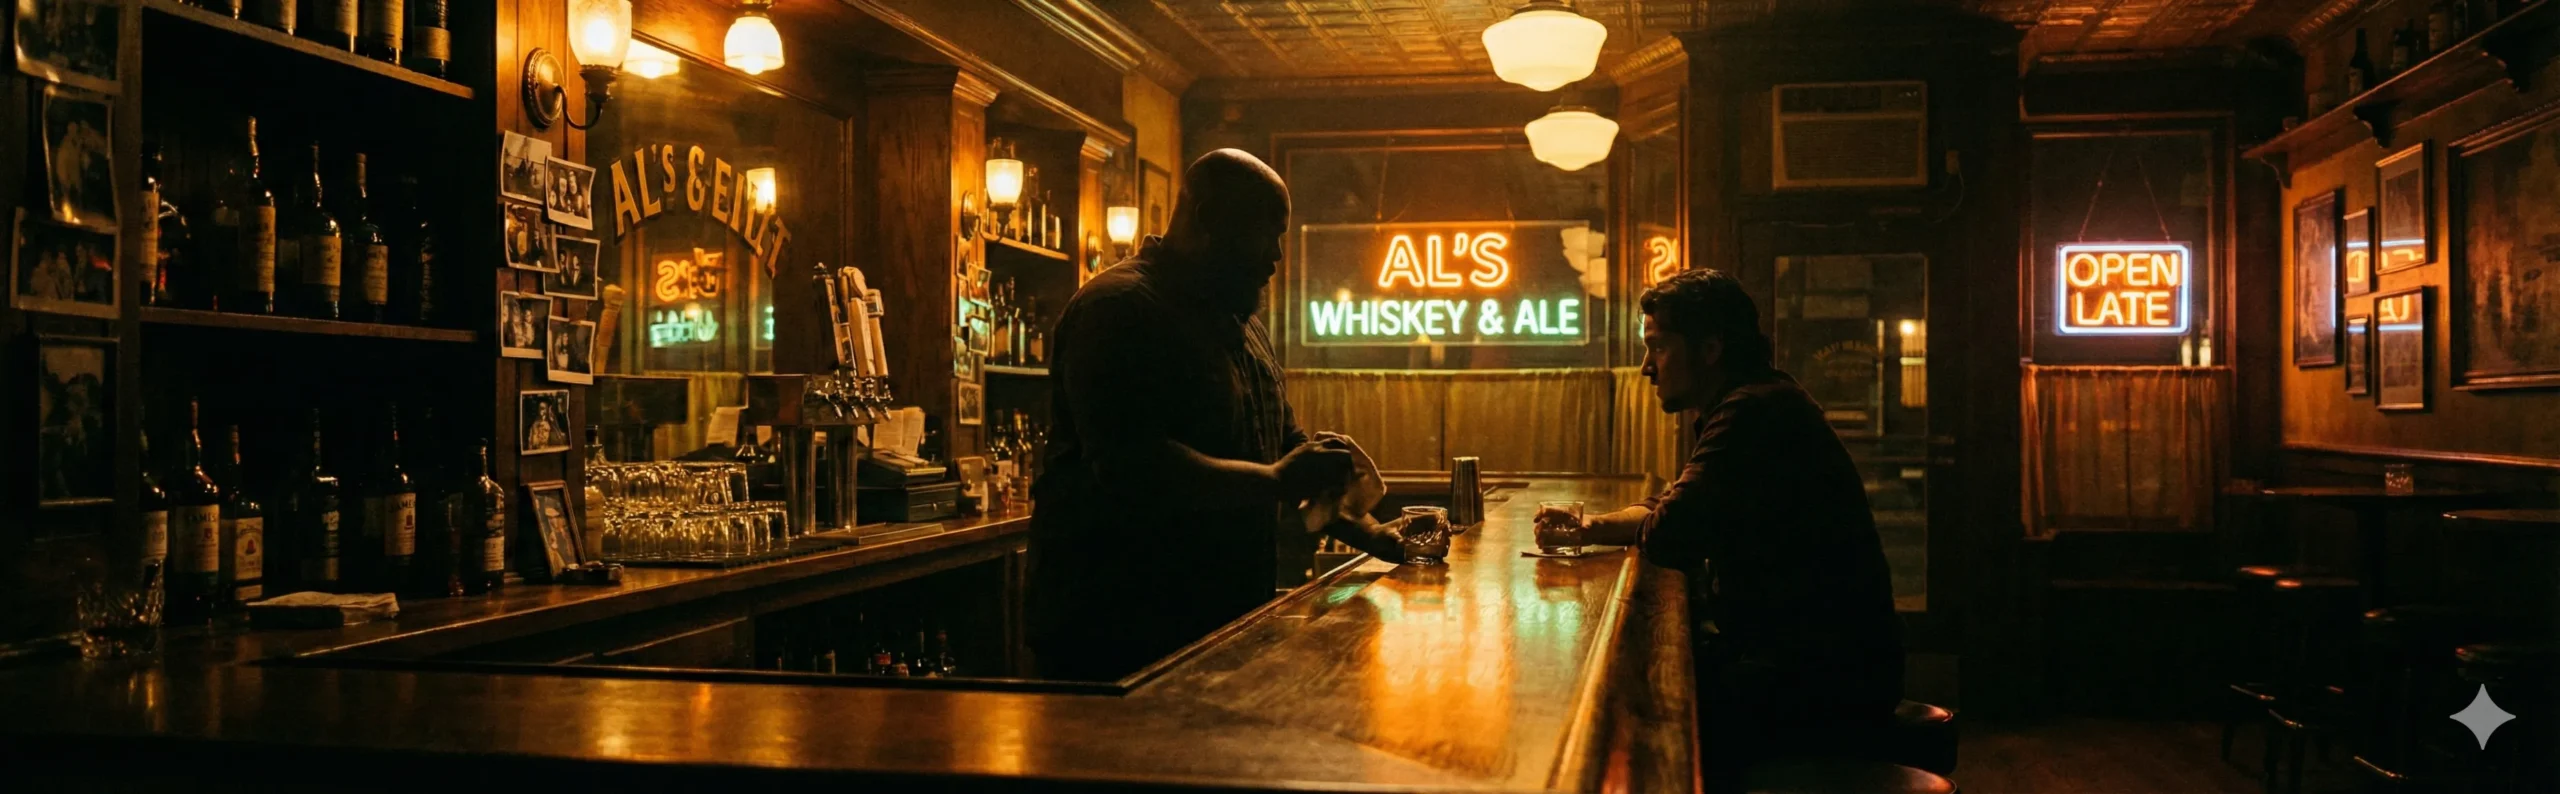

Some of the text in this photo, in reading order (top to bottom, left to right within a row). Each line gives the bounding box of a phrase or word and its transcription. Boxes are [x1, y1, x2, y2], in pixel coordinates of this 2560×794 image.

[611, 143, 676, 237] AL'S
[1378, 231, 1509, 288] AL'S
[2067, 252, 2179, 288] OPEN
[1309, 298, 1580, 336] WHISKEY & ALE
[2074, 291, 2171, 326] LATE
